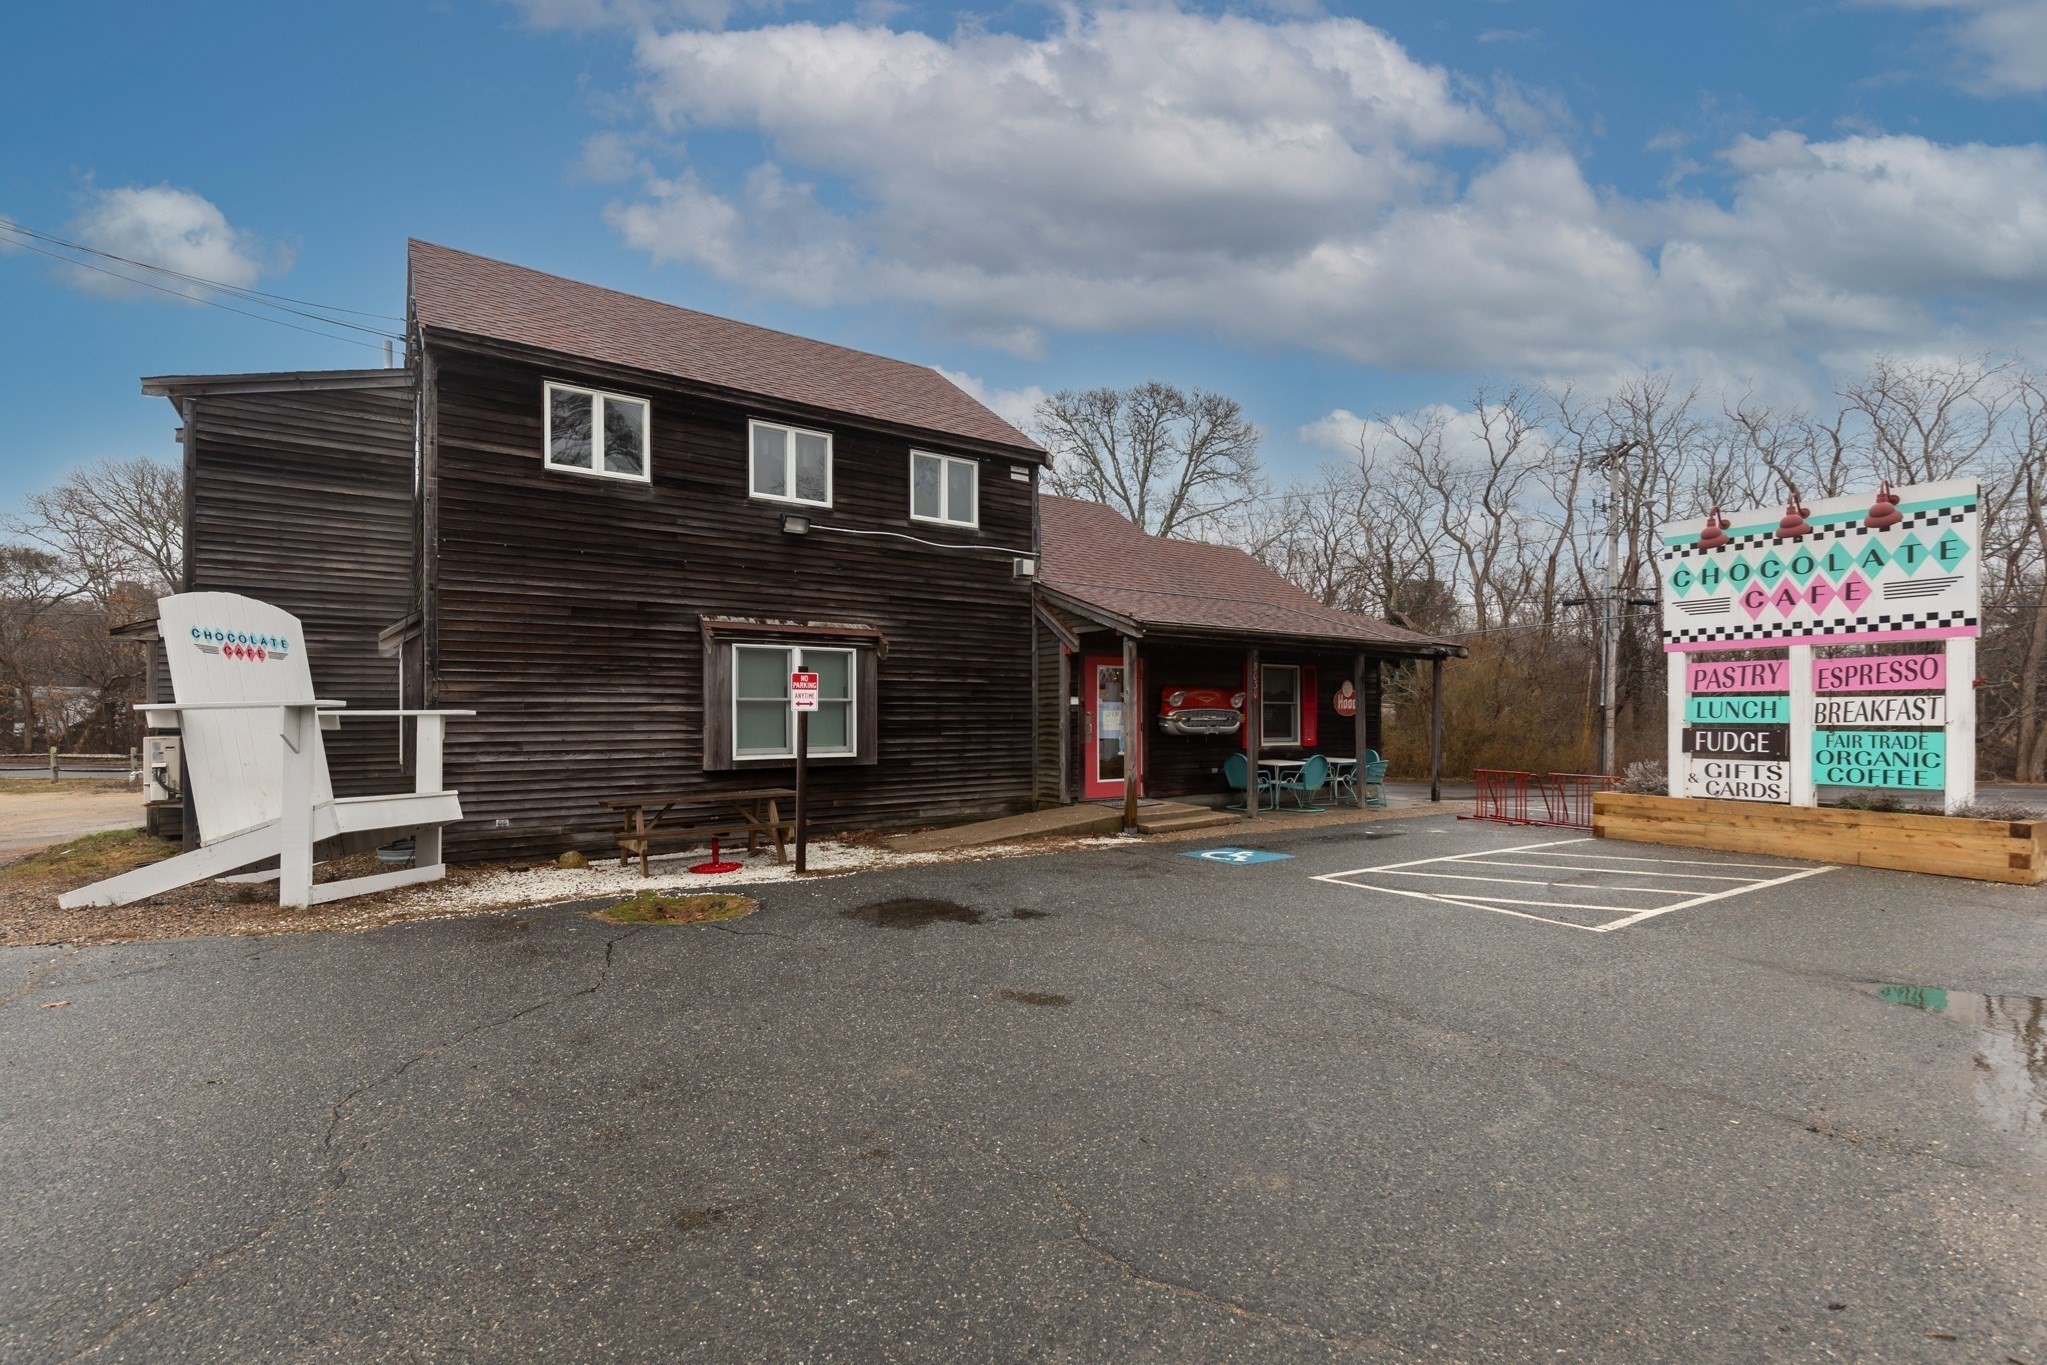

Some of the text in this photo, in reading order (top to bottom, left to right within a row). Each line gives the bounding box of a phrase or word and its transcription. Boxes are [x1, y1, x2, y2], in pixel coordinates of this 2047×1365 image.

[1673, 539, 1958, 588] CHOCOLATE
[1744, 581, 1862, 609] CAFE
[191, 628, 288, 649] CHOCOLATE
[223, 645, 265, 659] CAFE
[1693, 662, 1783, 691] PASTRY
[1817, 656, 1939, 690] ESPRESSO
[1696, 700, 1777, 720] LUNCH
[1814, 696, 1942, 725] BREAKFAST
[1695, 731, 1770, 753] FUDGE
[1825, 734, 1929, 750] FAIR TRADE
[1815, 750, 1941, 769] ORGANIC
[1704, 762, 1783, 782] GIFTS
[1827, 767, 1929, 787] COFFEE
[1688, 772, 1781, 800] & CARDS
